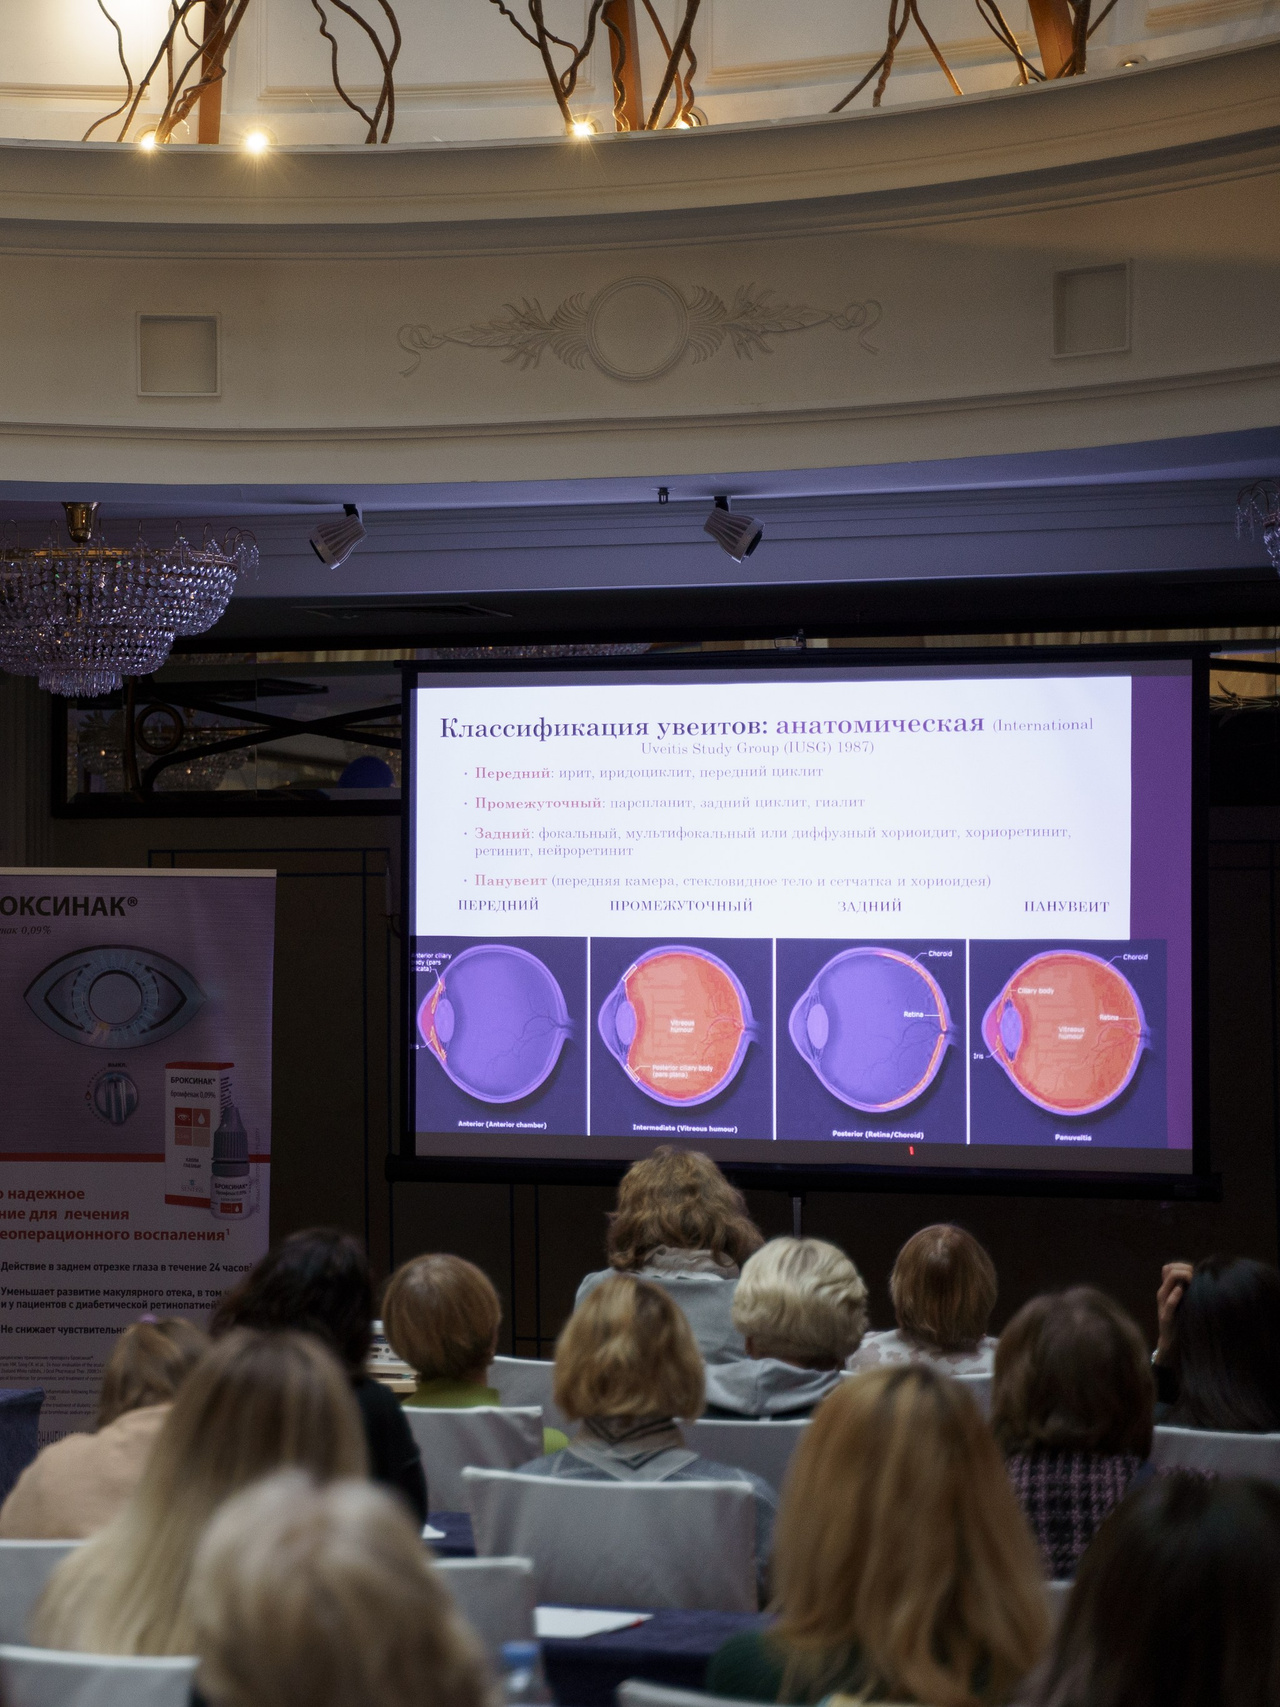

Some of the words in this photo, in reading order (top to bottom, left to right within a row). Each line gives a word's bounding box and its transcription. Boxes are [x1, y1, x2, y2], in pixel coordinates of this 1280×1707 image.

[440, 717, 648, 742] Классификация
[656, 720, 768, 740] увеитов:
[776, 717, 986, 734] анатомическая
[992, 718, 1094, 732] (International
[641, 742, 688, 756] Uveitis
[692, 742, 732, 757] Study
[736, 742, 780, 756] Group
[783, 741, 832, 756] (IUSG)
[837, 741, 874, 756] 1987)
[475, 766, 554, 781] Передний:
[558, 768, 596, 780] ирит,
[600, 768, 695, 780] иридоциклит,
[699, 766, 766, 780] передний
[772, 767, 824, 778] циклит
[475, 796, 606, 812] Промежуточный:
[610, 798, 696, 810] парспланит,
[700, 796, 750, 808] задний
[755, 798, 811, 810] циклит,
[816, 798, 866, 808] гиалит
[474, 827, 534, 842] Задний:
[538, 827, 621, 842] фокальный,
[626, 827, 756, 842] мультифокальный
[761, 829, 788, 839] или
[792, 826, 876, 842] диффузный
[881, 827, 960, 841] хориоидит,
[965, 826, 1072, 842] хориоретинит,
[474, 846, 533, 858] ретинит,
[538, 844, 634, 858] нейроретинит
[474, 874, 547, 889] Панувеит
[551, 875, 620, 888] (передняя
[624, 876, 678, 888] камера,
[683, 876, 778, 888] стекловидное
[782, 876, 812, 887] тело
[817, 878, 826, 886] и
[830, 876, 892, 888] сетчатка
[897, 878, 906, 886] и
[911, 874, 992, 889] хориоидея)
[458, 897, 540, 912] ПЕРЕДНИЙ
[610, 898, 754, 912] ПРОМЕЖУТОЧНЫЙ
[837, 898, 903, 913] ЗАДНИЙ
[1024, 899, 1110, 914] ПАНУВЕИТ
[21, 925, 52, 936] 0,09%
[486, 1120, 515, 1128] (Anterior
[516, 1122, 547, 1130] chamber)
[709, 1126, 738, 1134] humour)
[832, 1130, 864, 1138] Posterior
[8, 1189, 85, 1202] надежное
[29, 1210, 57, 1222] для
[64, 1210, 130, 1220] лечения
[1, 1262, 46, 1272] Действие
[56, 1264, 91, 1272] заднем
[93, 1264, 130, 1272] отрезке
[168, 1264, 207, 1272] течение
[210, 1262, 220, 1272] 24
[1, 1286, 54, 1296] Уменьшает
[56, 1288, 100, 1298] развитие
[103, 1289, 164, 1298] макулярного
[166, 1290, 195, 1298] отека,
[9, 1301, 14, 1310] у
[16, 1300, 66, 1310] пациентов
[76, 1300, 148, 1310] диабетической
[1, 1325, 13, 1334] Не
[15, 1326, 56, 1334] снижает
